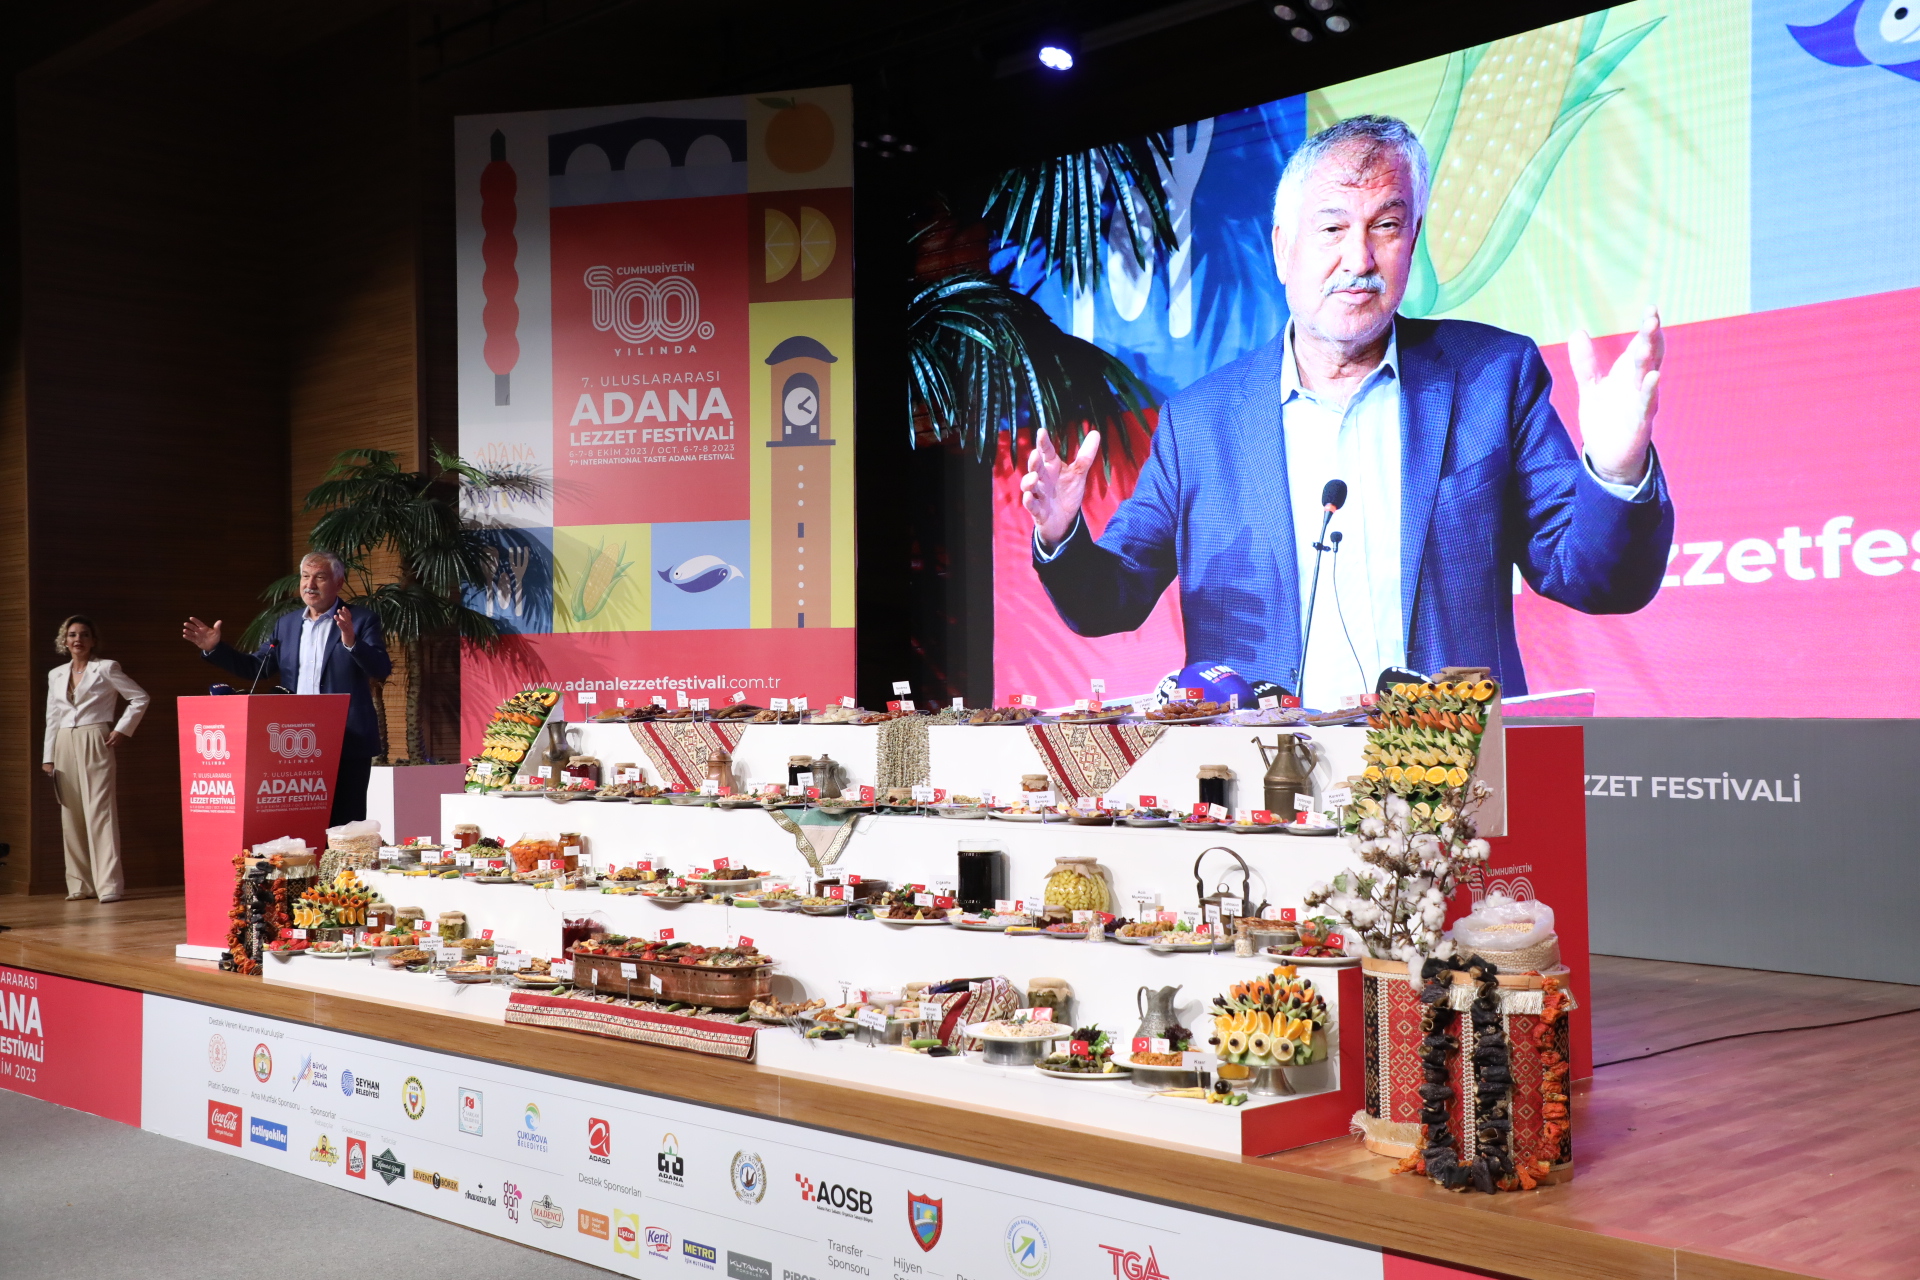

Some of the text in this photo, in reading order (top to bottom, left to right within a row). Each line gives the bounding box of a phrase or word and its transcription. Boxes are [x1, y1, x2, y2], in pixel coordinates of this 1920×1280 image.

[616, 261, 695, 277] CUMHURİYETİN
[614, 344, 698, 357] YILINDA
[581, 371, 720, 388] 7. ULUSLARARASI
[569, 387, 733, 426] ADANA
[570, 421, 734, 446] LEZZET FESTİVALİ
[597, 448, 621, 457] EKİM
[625, 447, 647, 455] 2023
[657, 445, 680, 454] OCT.
[683, 445, 709, 453] 6-7-8
[712, 443, 735, 452] 2023
[580, 456, 641, 466] INTERNATIONAL
[643, 455, 667, 463] TASTE
[669, 454, 697, 462] ADANA
[699, 452, 735, 461] FESTIVAL
[1660, 515, 1920, 589] zetfe
[522, 674, 781, 693] www.adanalezzetfestivali.com.tr
[272, 770, 323, 778] ULUSLARARASI
[190, 780, 235, 796] ADANA
[257, 778, 327, 796] ADANA
[1651, 772, 1801, 803] FESTİVALİ
[210, 796, 236, 805] FESTİVALİ
[257, 792, 328, 805] LEZZET FESTİVALİ
[1486, 863, 1532, 877] CUMHURİYETİN
[0, 971, 38, 990] ARARASI
[209, 1016, 224, 1027] Destek
[224, 1020, 238, 1030] Veren
[239, 1022, 254, 1033] Kurum
[261, 1027, 285, 1040] Kuruluşlar
[0, 1035, 44, 1063] ESTİVALİ
[15, 1064, 36, 1083] 2023
[312, 1062, 328, 1071] BÜYÜK
[208, 1079, 240, 1096] Platin Sponsor
[311, 1079, 328, 1089] ADANA
[355, 1077, 380, 1091] SEYHAN
[251, 1091, 300, 1112] Ana Mutfak Sponsoru
[355, 1087, 380, 1099] BELEDİYESİ
[310, 1105, 337, 1120] Sponsorlar
[517, 1130, 548, 1145] ÇUKUROVA
[588, 1154, 610, 1165] ADASO
[413, 1171, 459, 1190] LEVENT BÖREK
[578, 1172, 641, 1198] Destek Sponsorları
[658, 1171, 684, 1182] ADANA
[817, 1181, 873, 1215] AOSB
[533, 1207, 561, 1223] MADENCİ
[618, 1228, 636, 1241] Lipton
[647, 1229, 669, 1244] Kent
[684, 1243, 715, 1260] METRO
[828, 1238, 864, 1257] Transfer
[828, 1255, 870, 1276] Sponsoru
[893, 1256, 922, 1275] Hijyen
[1099, 1244, 1169, 1280] TGA
